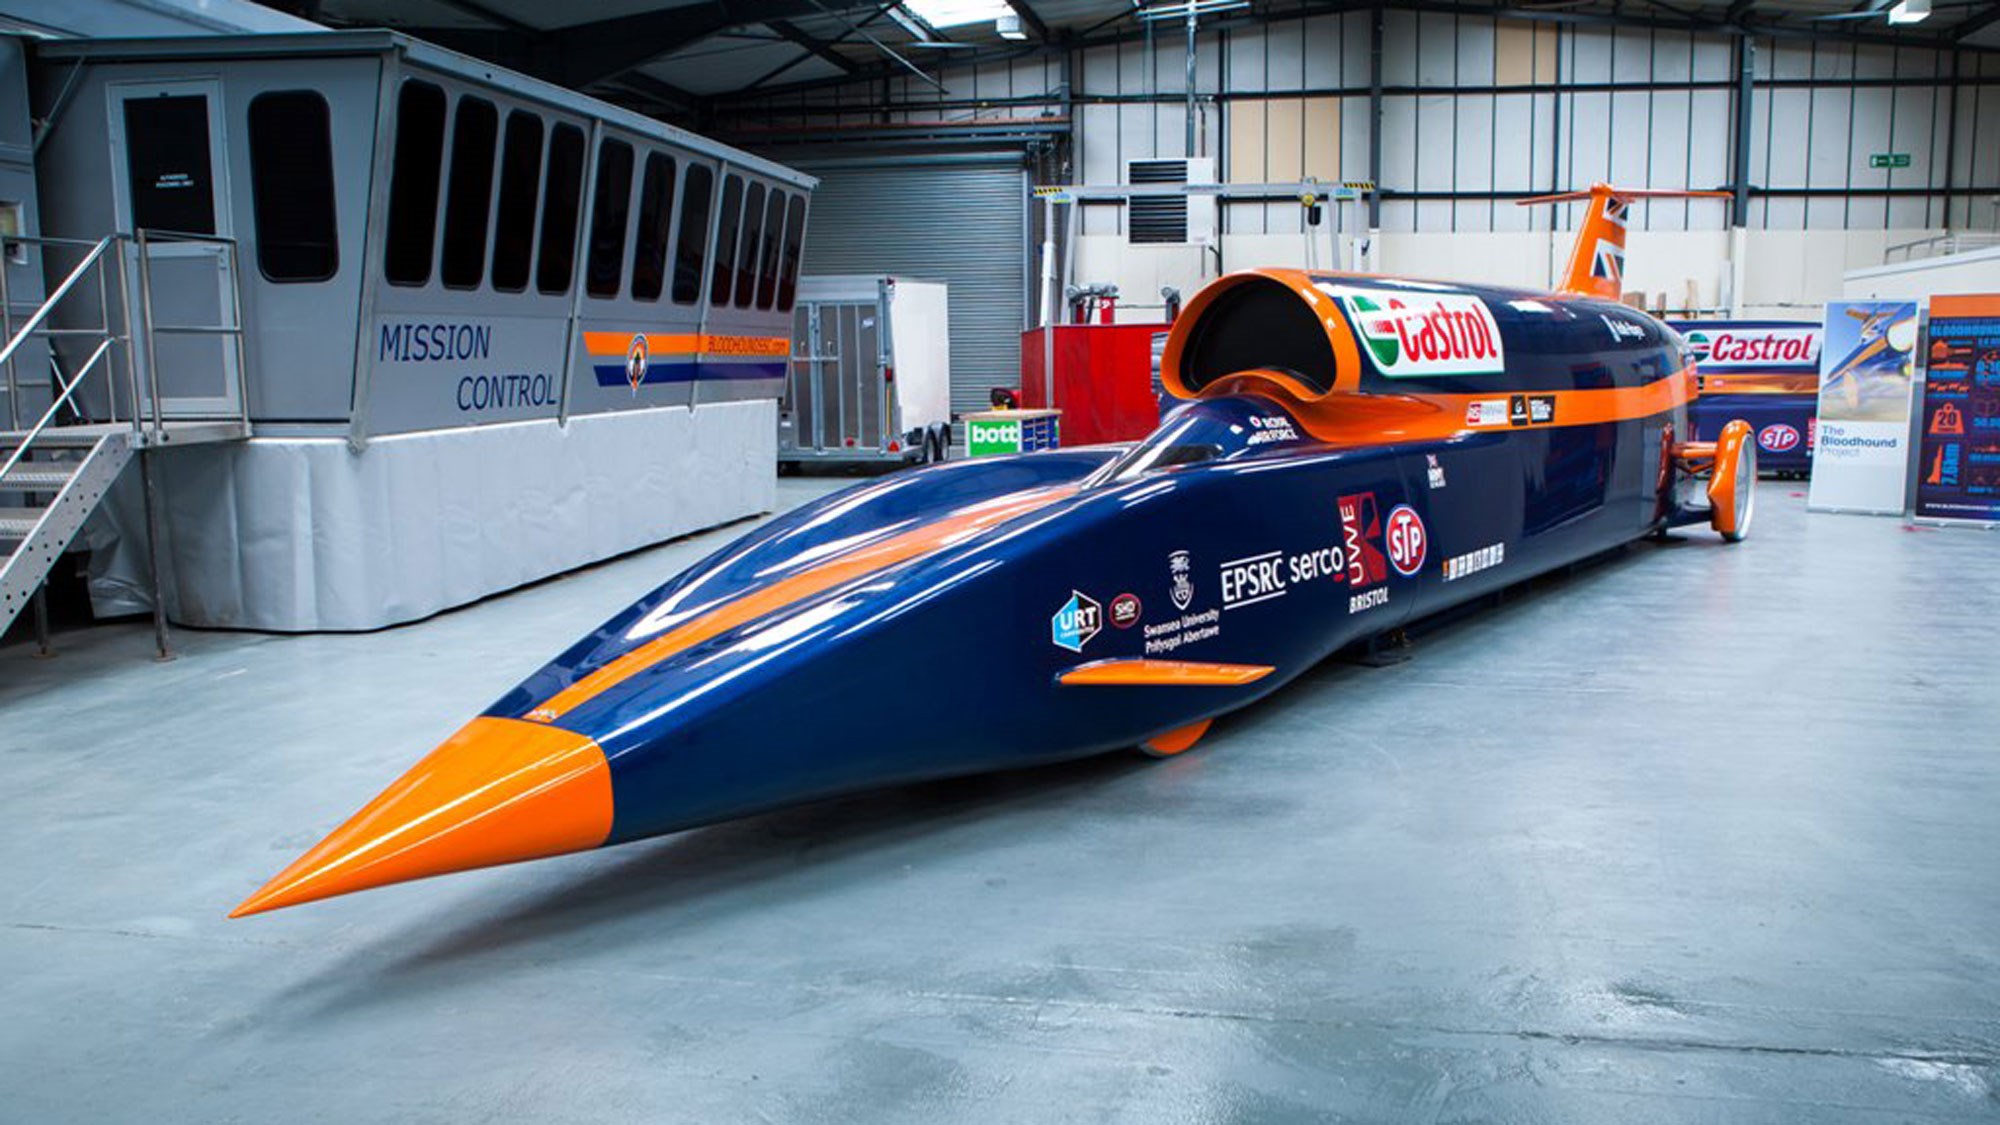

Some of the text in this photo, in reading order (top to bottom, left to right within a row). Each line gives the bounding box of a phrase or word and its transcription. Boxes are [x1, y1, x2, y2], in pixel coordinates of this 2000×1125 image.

[379, 323, 491, 362] MISSION
[1389, 298, 1498, 362] Castrol
[1711, 333, 1813, 362] Castrol
[456, 373, 557, 411] CONTROL
[972, 424, 1019, 443] bott
[1763, 428, 1795, 448] STP
[1820, 436, 1897, 449] Bloodhound
[1821, 425, 1845, 436] The
[1339, 503, 1365, 586] UWE
[1391, 514, 1422, 566] STP
[1221, 557, 1286, 603] EPSRC
[1289, 546, 1345, 584] serco
[1349, 586, 1389, 615] BRISTOL
[1060, 606, 1097, 631] URT
[1144, 608, 1220, 638] Swansea University
